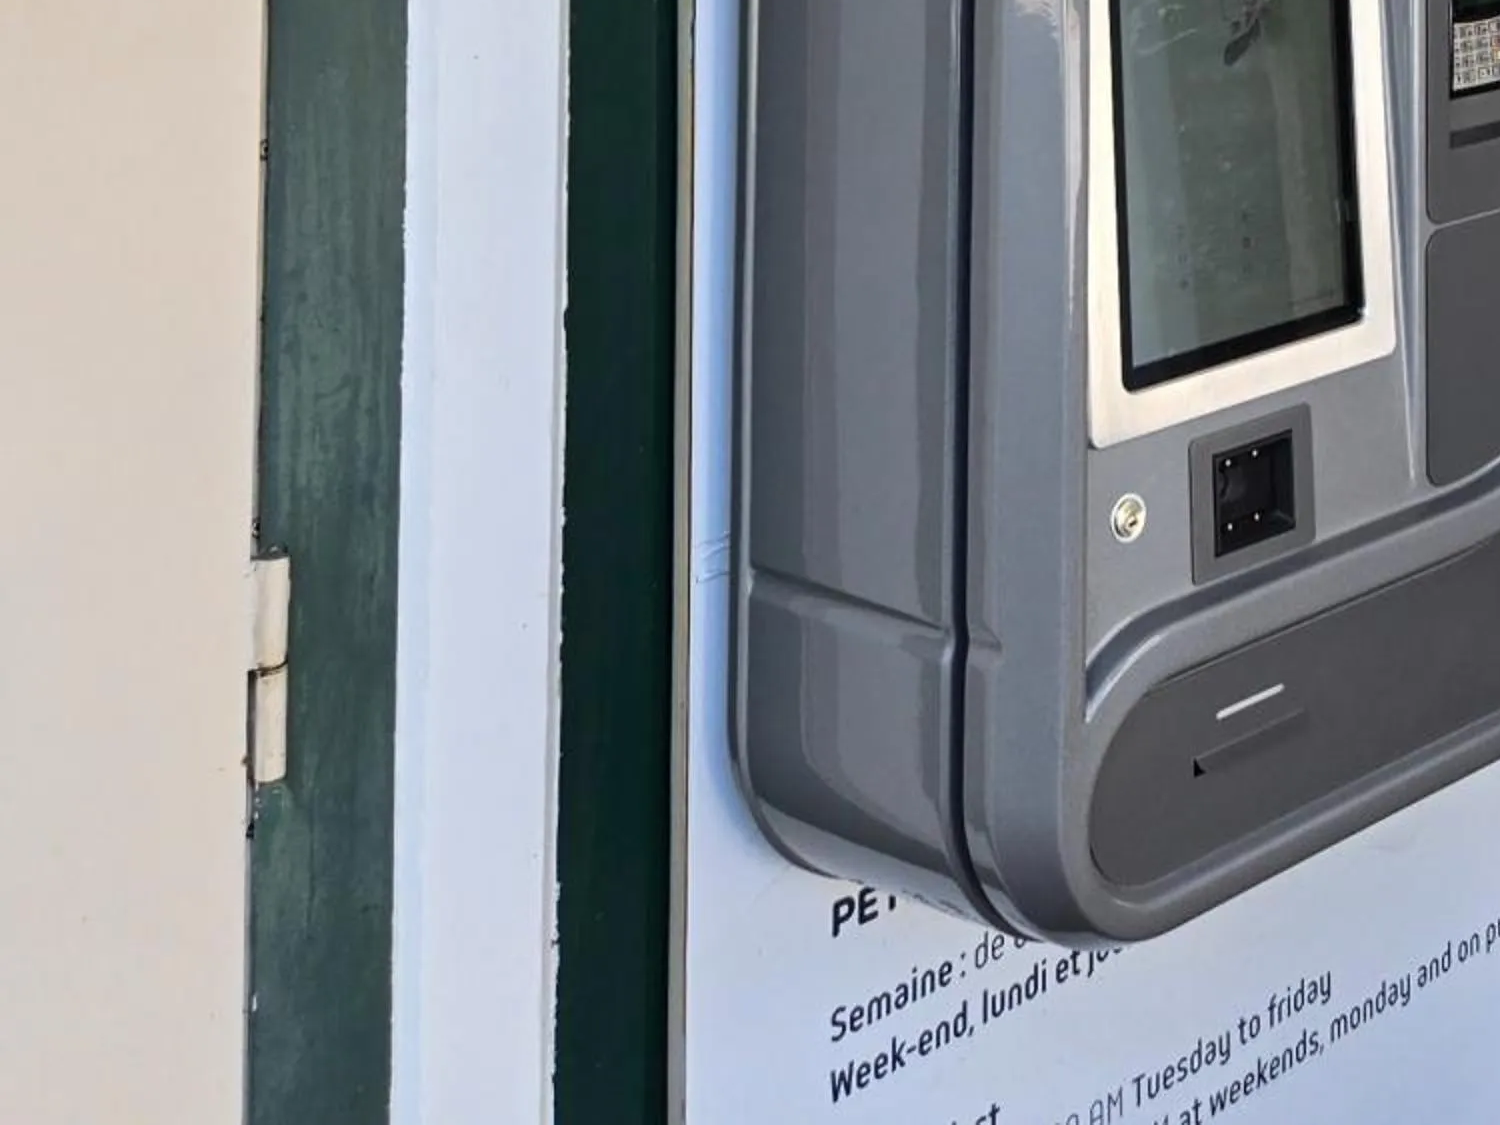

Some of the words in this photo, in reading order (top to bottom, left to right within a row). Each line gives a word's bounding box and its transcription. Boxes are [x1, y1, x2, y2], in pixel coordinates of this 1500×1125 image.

[975, 930, 1004, 969] de
[830, 1000, 975, 1104] Week-end,
[983, 959, 1047, 1024] lundi
[1056, 949, 1081, 983] et
[1133, 1030, 1231, 1108] Tuesday
[1238, 1016, 1261, 1046] to
[1267, 971, 1332, 1029] friday
[1180, 1100, 1202, 1125] at
[1208, 1021, 1324, 1117] weekends,
[1330, 972, 1411, 1044] monday
[1417, 942, 1451, 988] and
[1457, 931, 1481, 963] on
